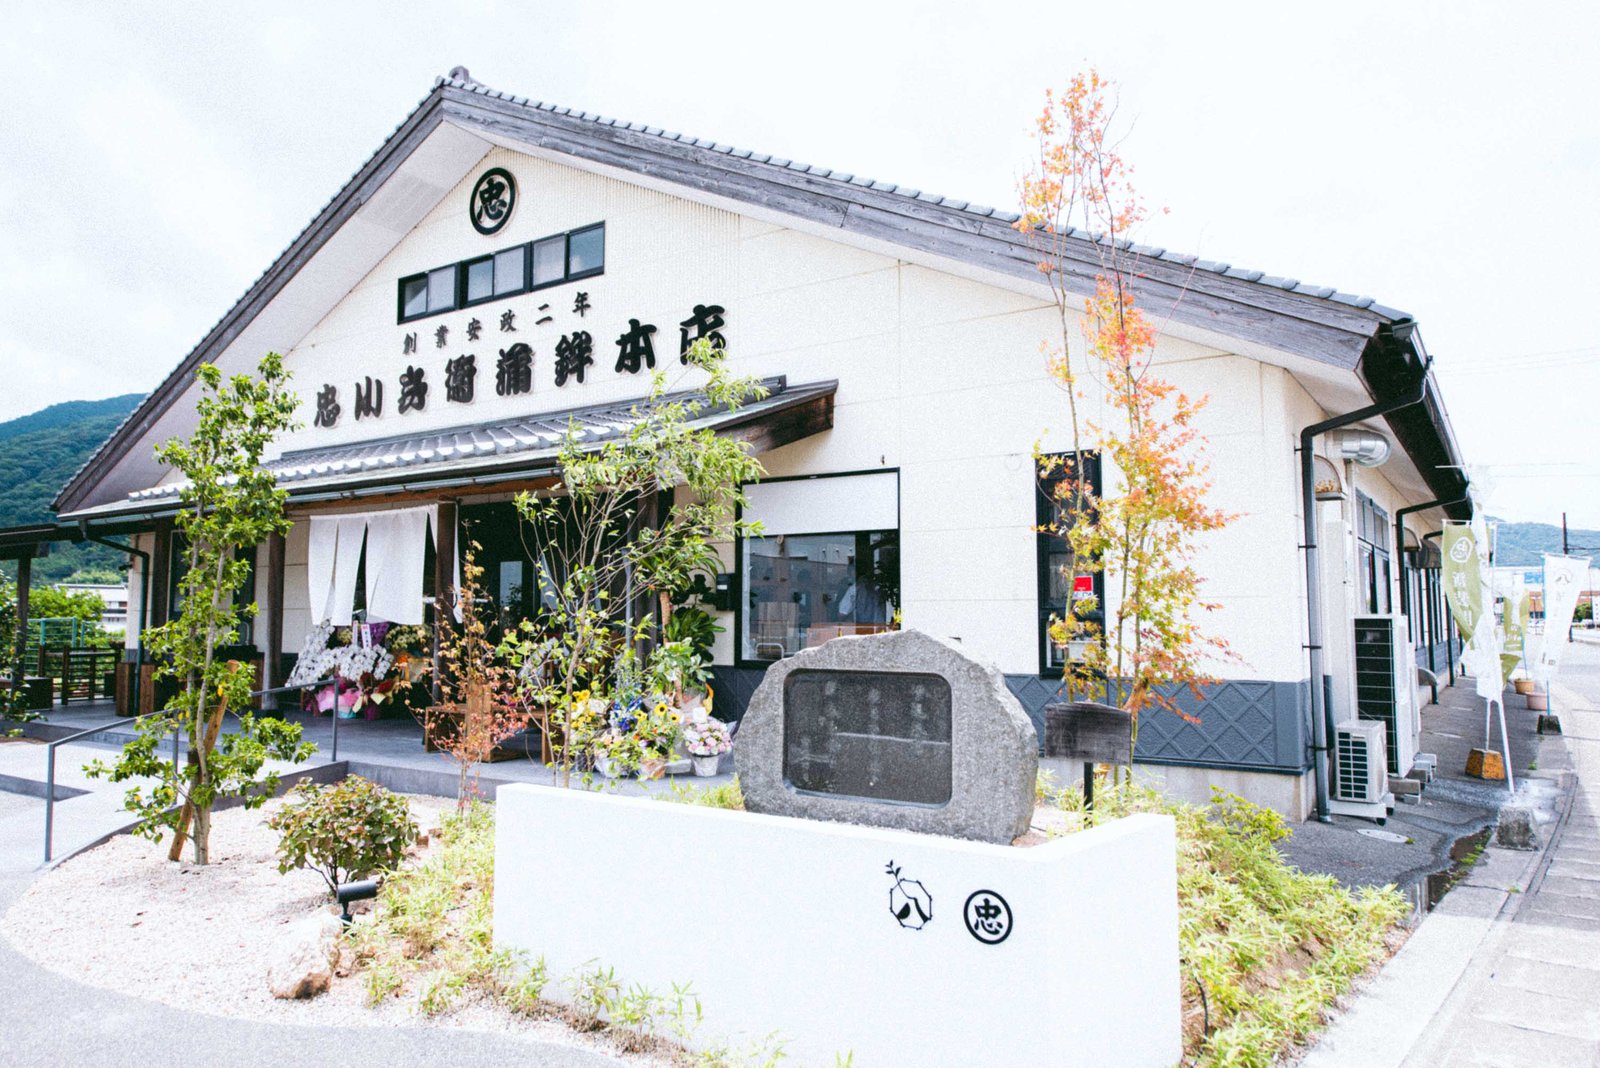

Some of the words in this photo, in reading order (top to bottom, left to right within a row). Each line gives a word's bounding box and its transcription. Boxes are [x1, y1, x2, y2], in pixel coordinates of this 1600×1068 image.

[476, 177, 508, 223] 忠
[402, 291, 592, 356] 創業安政二年
[973, 897, 1004, 936] 忠
